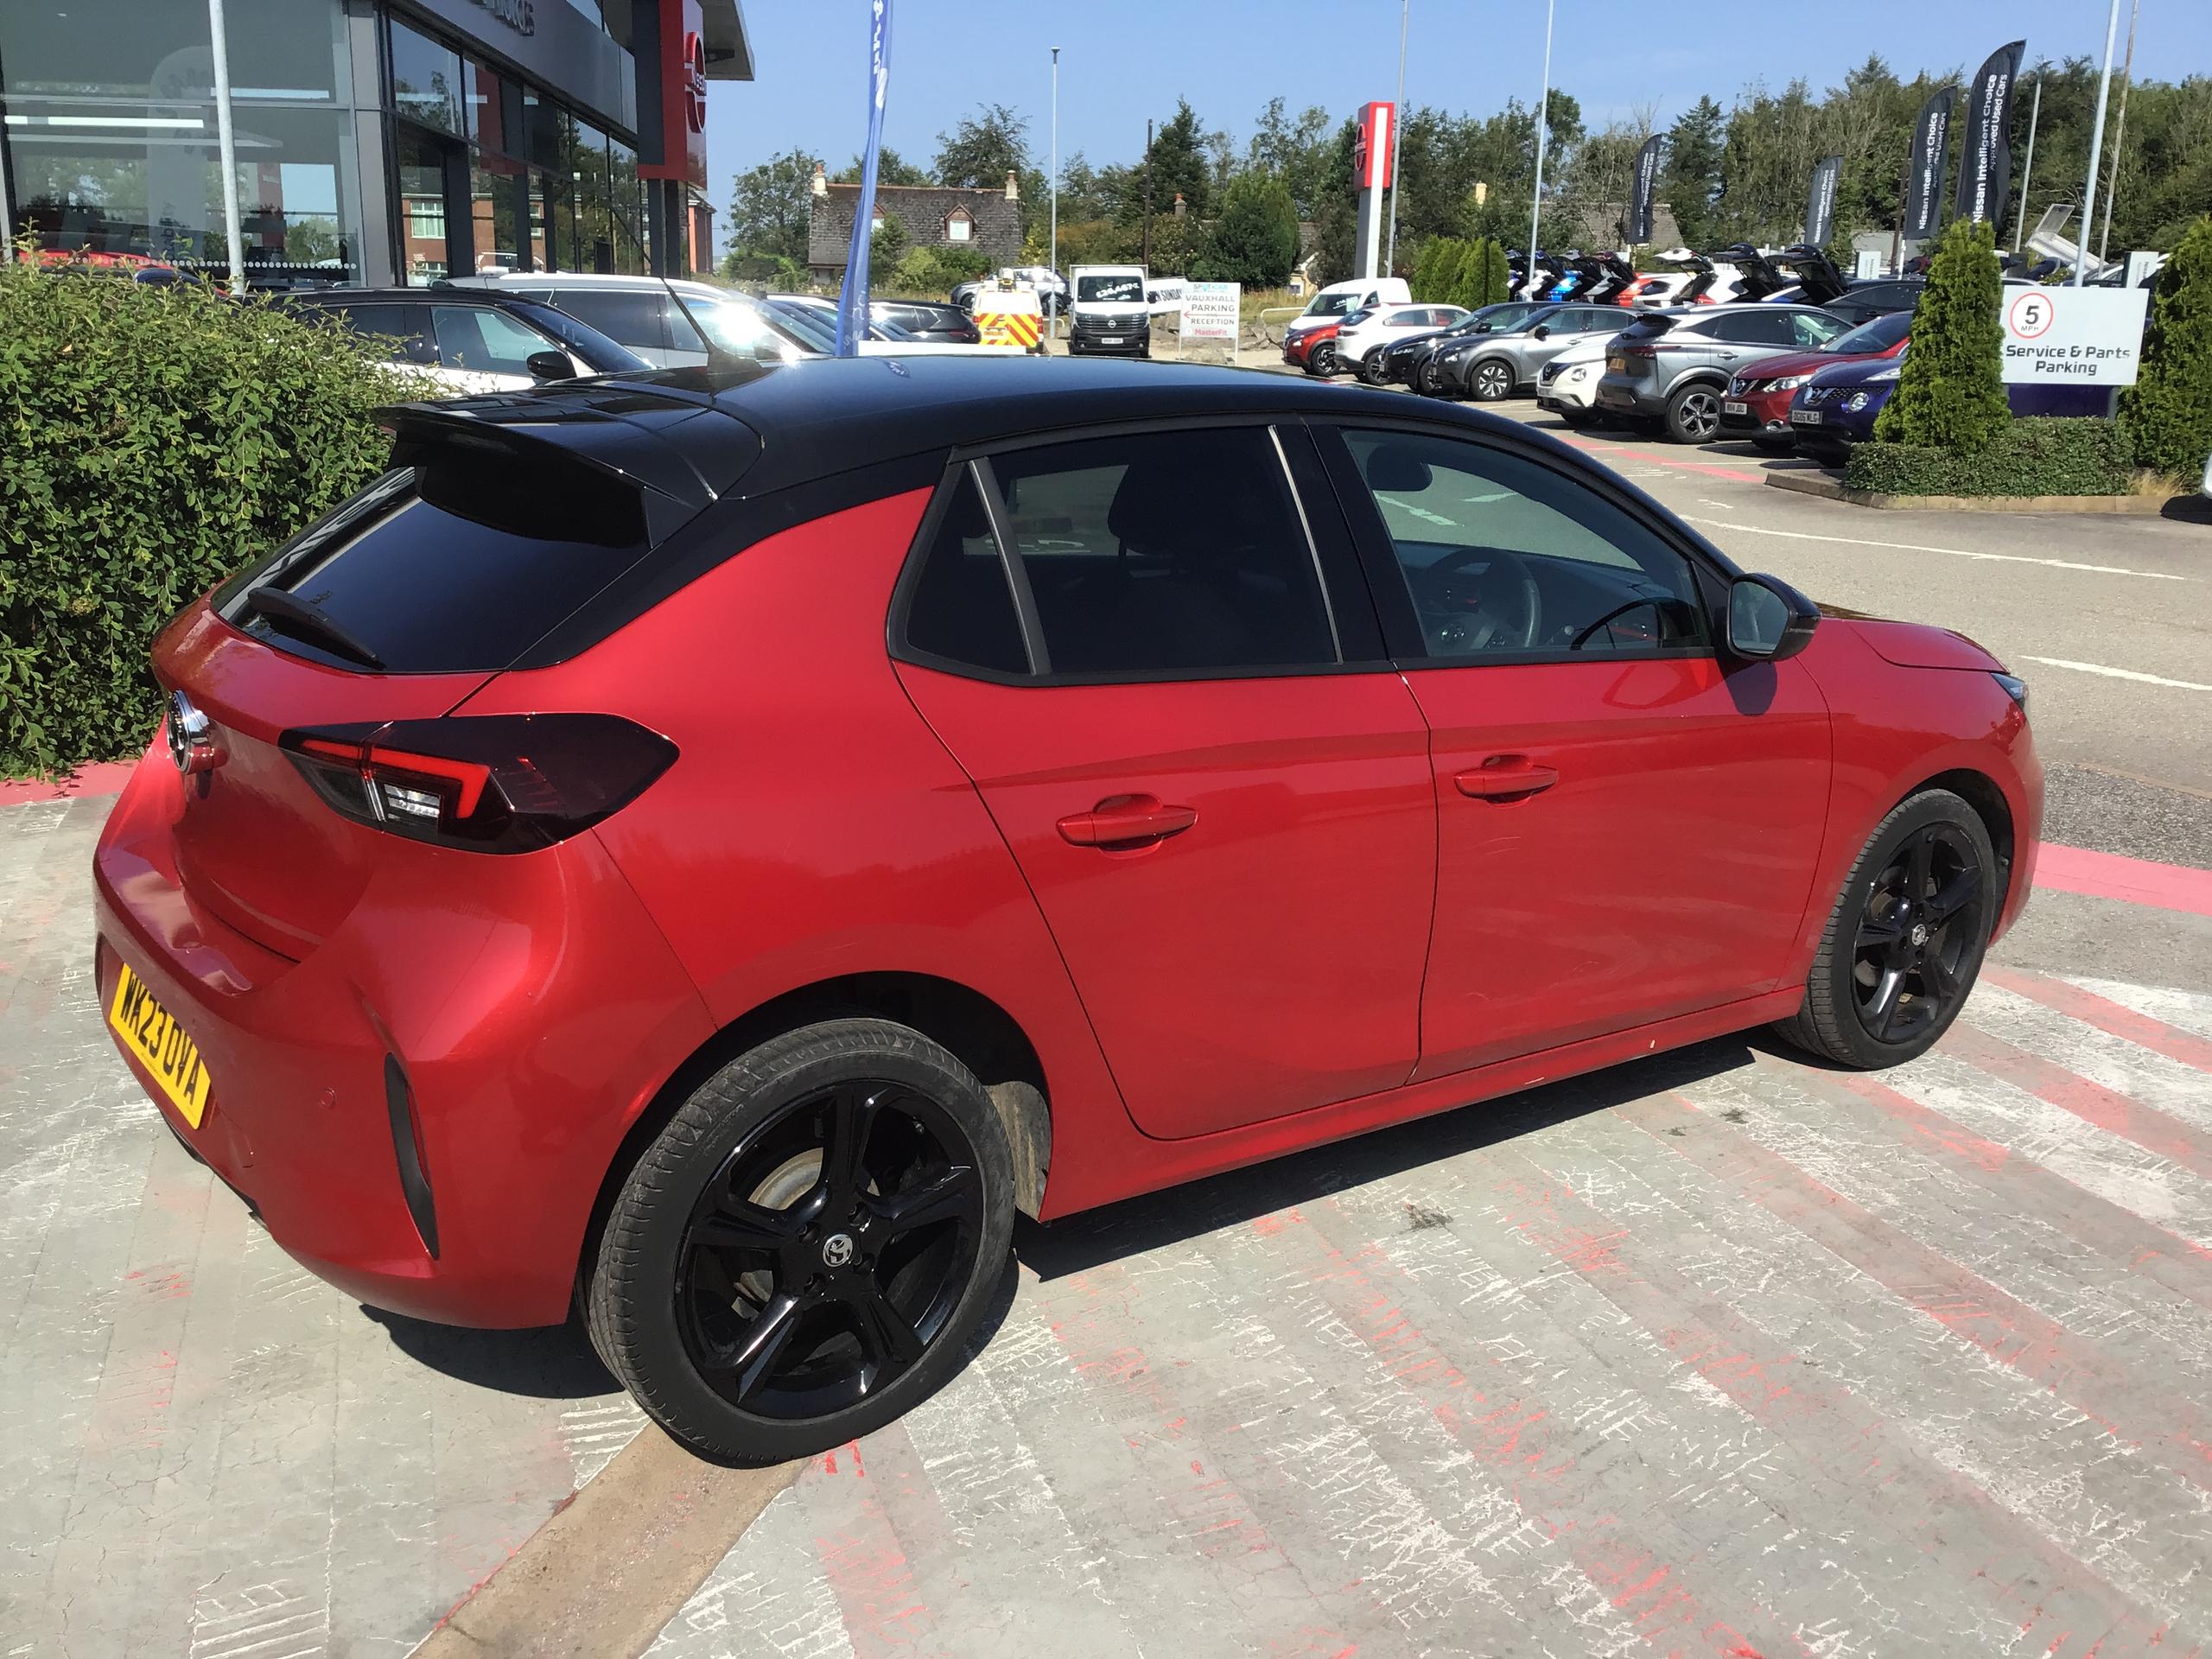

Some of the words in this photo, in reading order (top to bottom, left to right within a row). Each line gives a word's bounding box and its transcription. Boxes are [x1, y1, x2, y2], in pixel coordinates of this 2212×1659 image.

[1984, 74, 1997, 117] Choice
[1996, 74, 2007, 98] Cars
[1927, 111, 1938, 146] Choice
[1993, 99, 2003, 123] Used
[1979, 118, 1990, 181] Intelligent
[1990, 124, 1999, 170] Approved
[1923, 147, 1935, 195] Intelligent
[1919, 198, 1929, 230] Nissan
[1973, 182, 1986, 223] Nissan
[2024, 305, 2040, 325] 5
[2005, 345, 2066, 358] Service
[2069, 346, 2082, 358] &
[2085, 346, 2131, 359] Parts
[2035, 360, 2098, 376] Parking
[120, 969, 168, 1059] WK23
[162, 1020, 201, 1106] OVA
